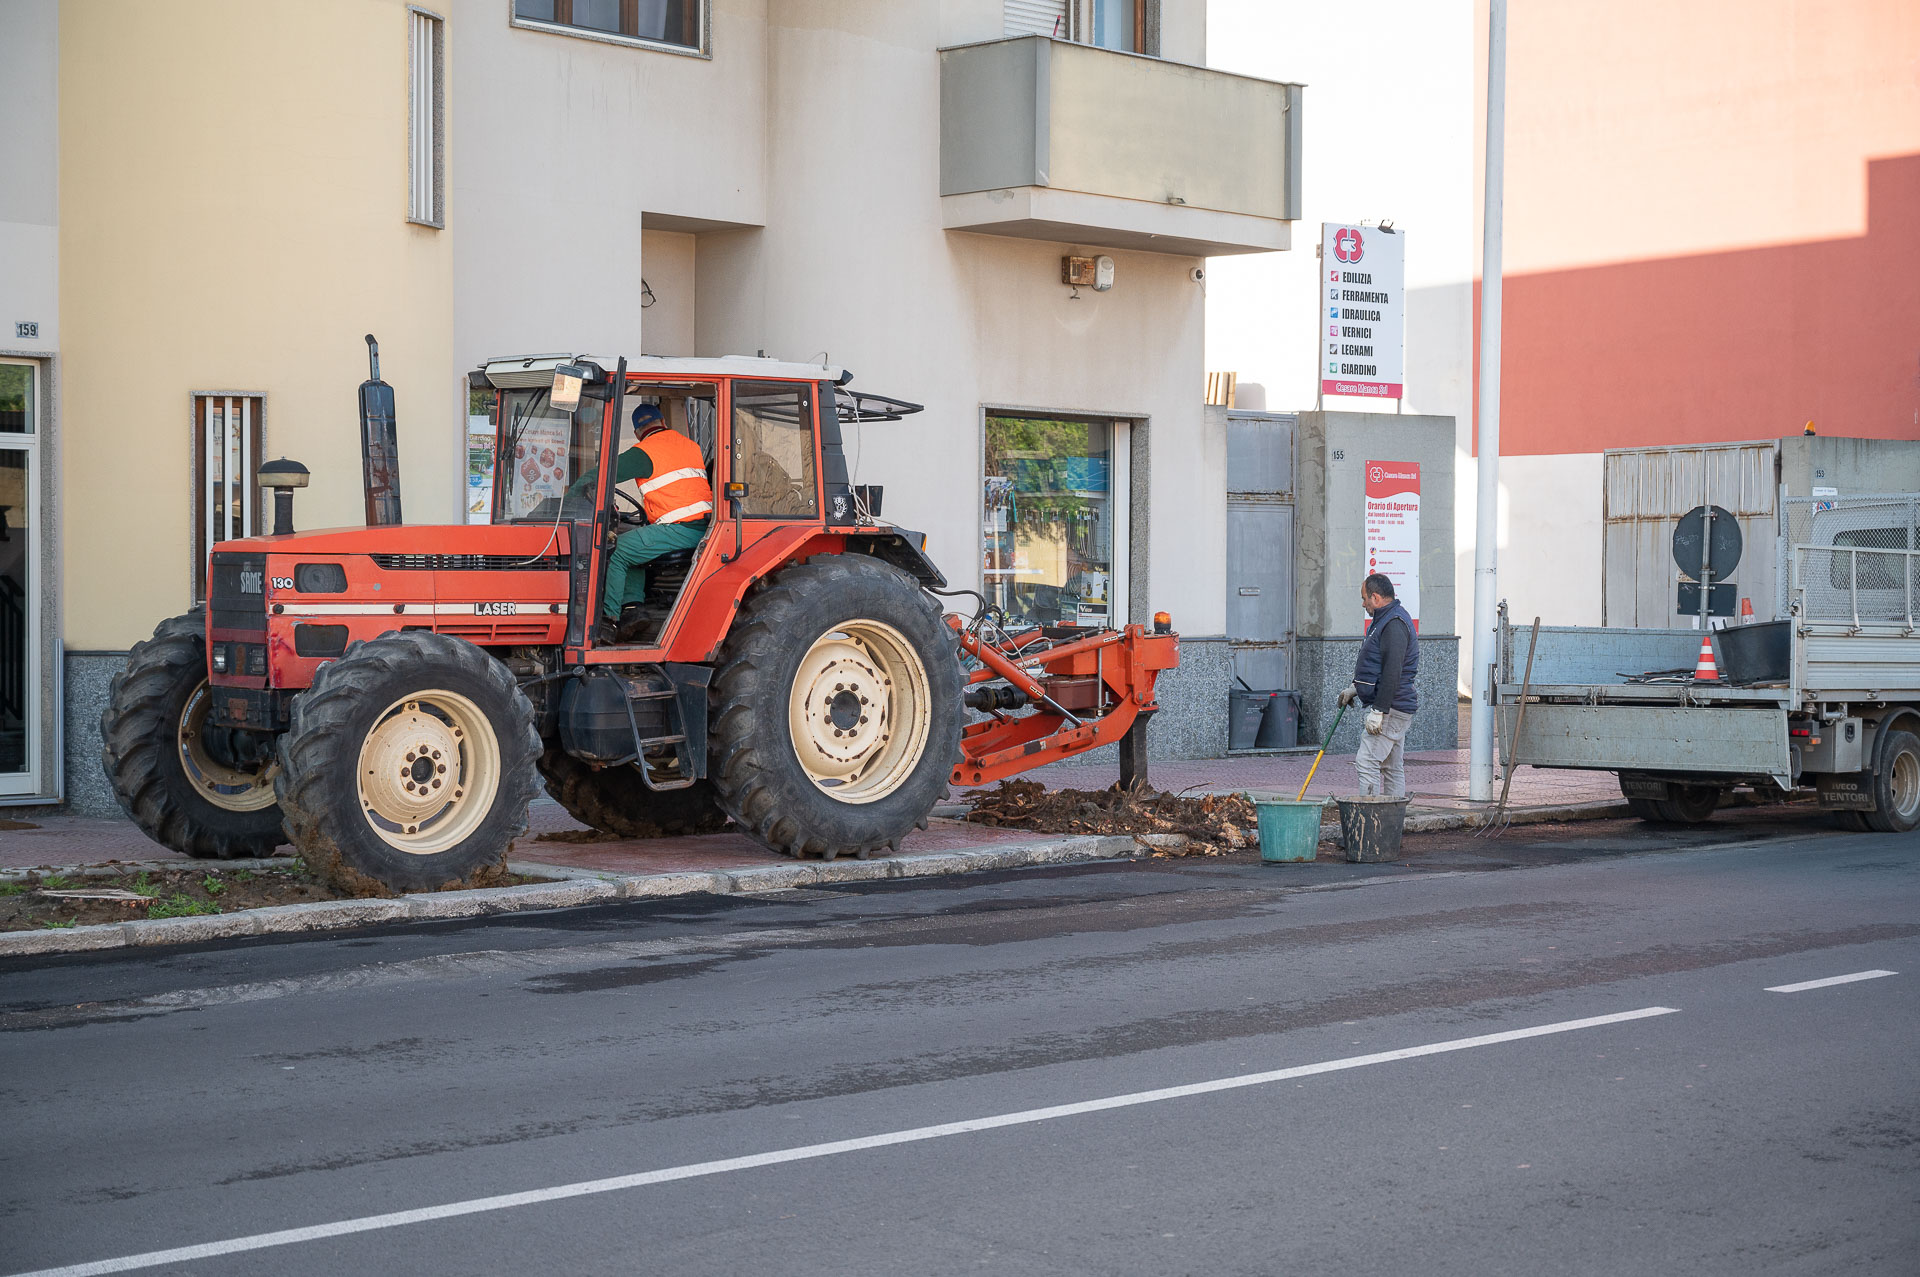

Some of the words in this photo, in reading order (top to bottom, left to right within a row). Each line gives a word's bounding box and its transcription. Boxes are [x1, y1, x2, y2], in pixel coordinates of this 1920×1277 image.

[1342, 272, 1372, 285] EDILIZIA
[1342, 289, 1389, 304] FERRAMENTA
[1342, 308, 1381, 322] IDRAULICA
[19, 323, 36, 336] 159
[1342, 326, 1372, 339] VERNICI
[1341, 344, 1374, 357] LEGNAMI
[1341, 363, 1377, 376] GIARDINO
[1336, 382, 1357, 393] Cesare
[1358, 383, 1378, 395] Manca
[1379, 384, 1388, 395] Srl
[1333, 450, 1344, 460] 155
[1816, 469, 1825, 478] 153
[1368, 501, 1386, 510] Orario
[1387, 502, 1393, 511] di
[1393, 502, 1419, 512] Apertura
[240, 571, 262, 594] SAME
[271, 577, 294, 589] 130
[474, 602, 516, 616] LASER
[1624, 781, 1662, 792] TENTORI
[1823, 792, 1868, 802] TENTORI
